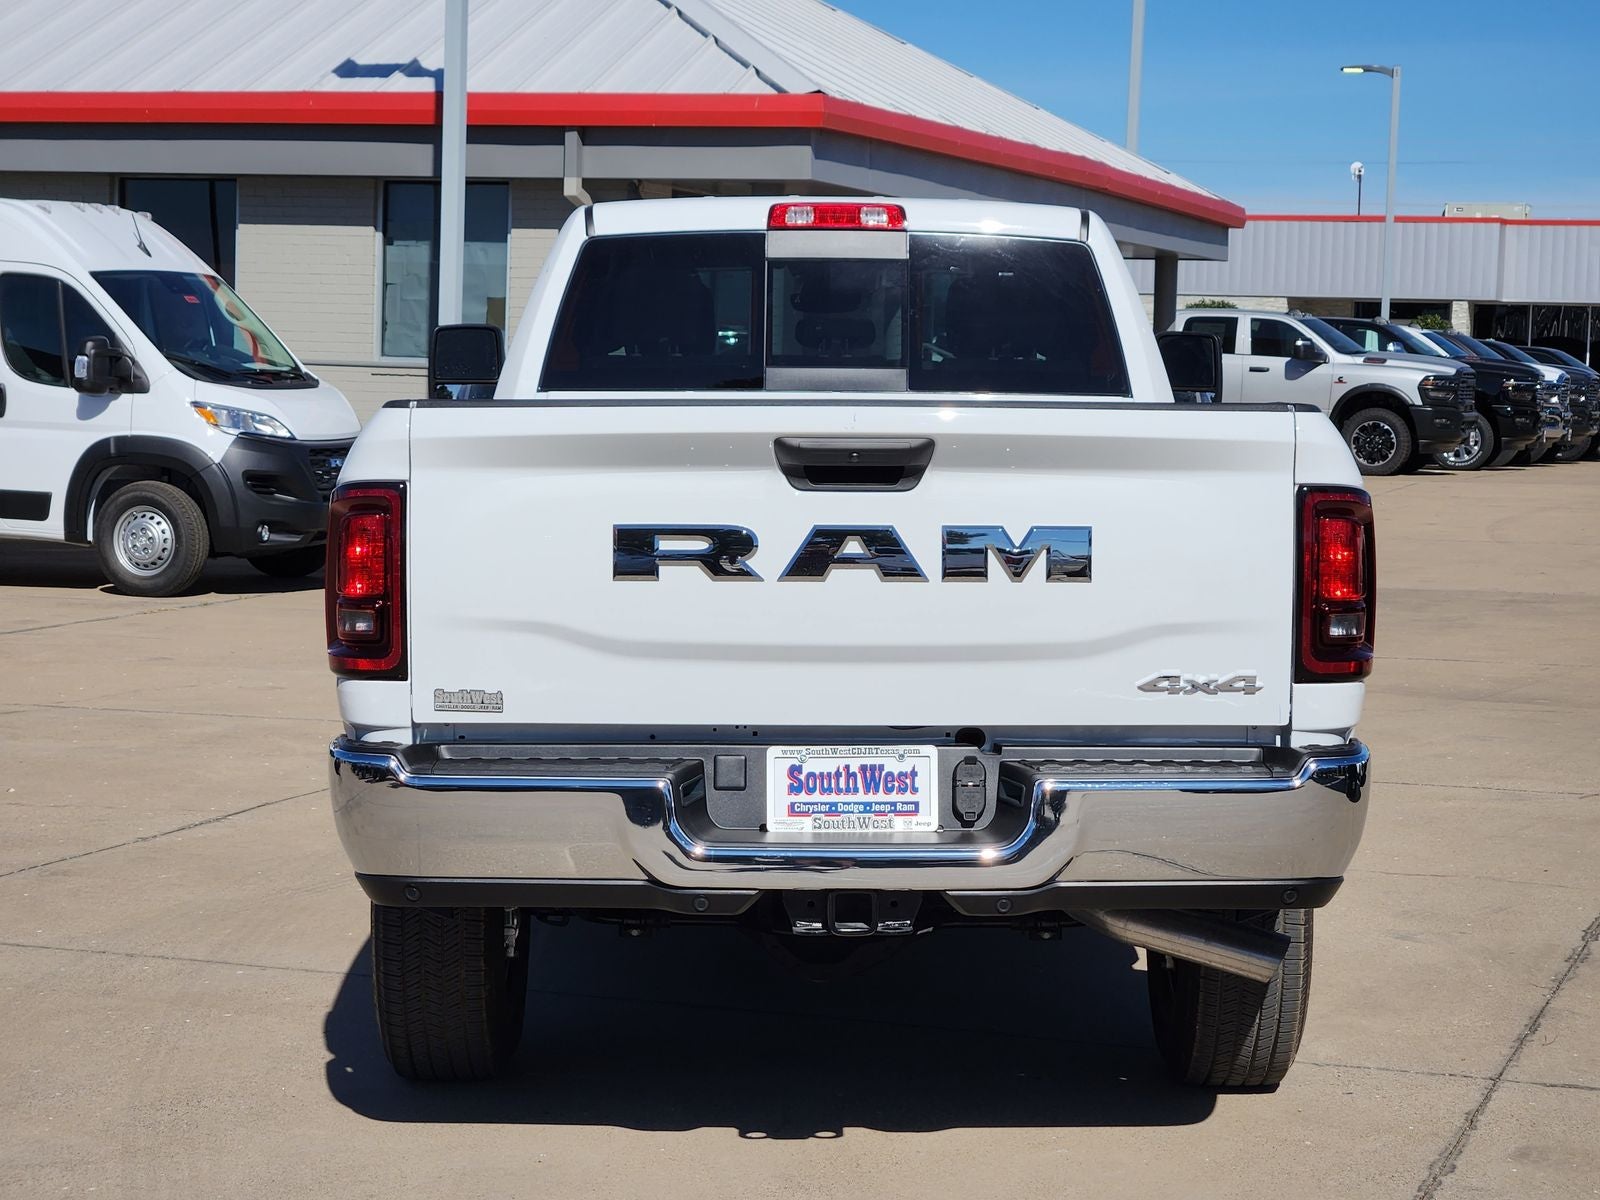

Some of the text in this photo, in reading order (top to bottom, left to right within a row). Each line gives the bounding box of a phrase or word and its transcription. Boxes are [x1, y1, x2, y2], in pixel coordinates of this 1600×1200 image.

[613, 523, 1093, 584] RAM
[434, 688, 503, 704] SouthWest
[788, 763, 919, 796] SouthWest
[794, 802, 915, 813] Chrysler Dodge Jeep Ram
[812, 815, 895, 831] SouthWest
